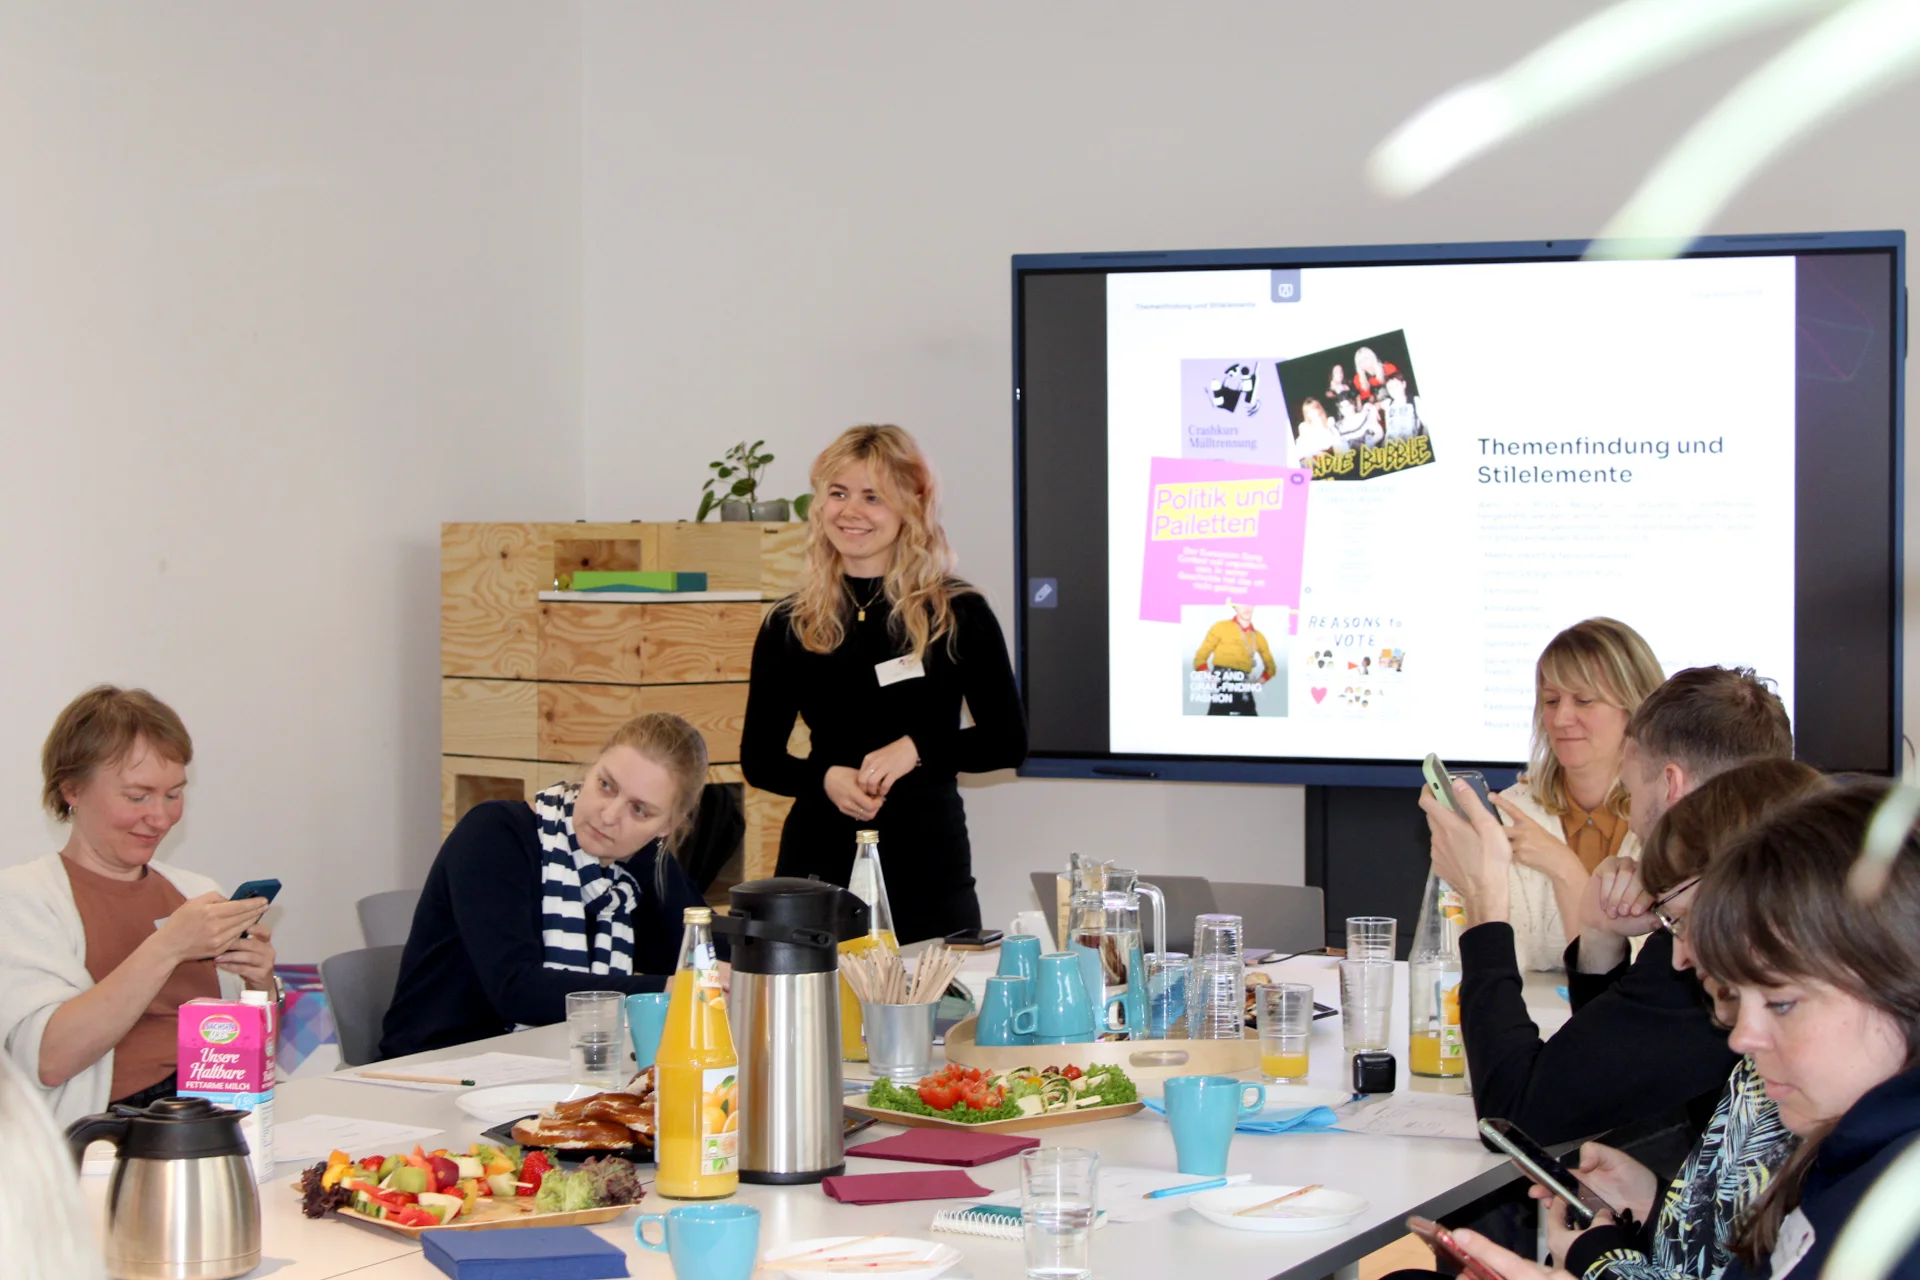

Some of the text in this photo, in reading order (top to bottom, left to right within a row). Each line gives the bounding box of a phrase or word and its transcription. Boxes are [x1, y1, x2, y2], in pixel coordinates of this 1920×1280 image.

[1188, 424, 1239, 436] Crashkurs
[1359, 435, 1432, 478] BUBBLE
[1478, 437, 1723, 459] Themenfindung und
[1478, 465, 1633, 483] Stilelemente
[1156, 484, 1281, 511] Politik und
[1154, 514, 1256, 537] Pailetten
[1308, 615, 1403, 629] REASONS to
[1334, 633, 1376, 647] VOTE
[1223, 671, 1245, 681] AND
[200, 1047, 241, 1063] Unsere
[190, 1062, 247, 1081] Haltbare
[185, 1081, 251, 1091] FETTARME MILCH
